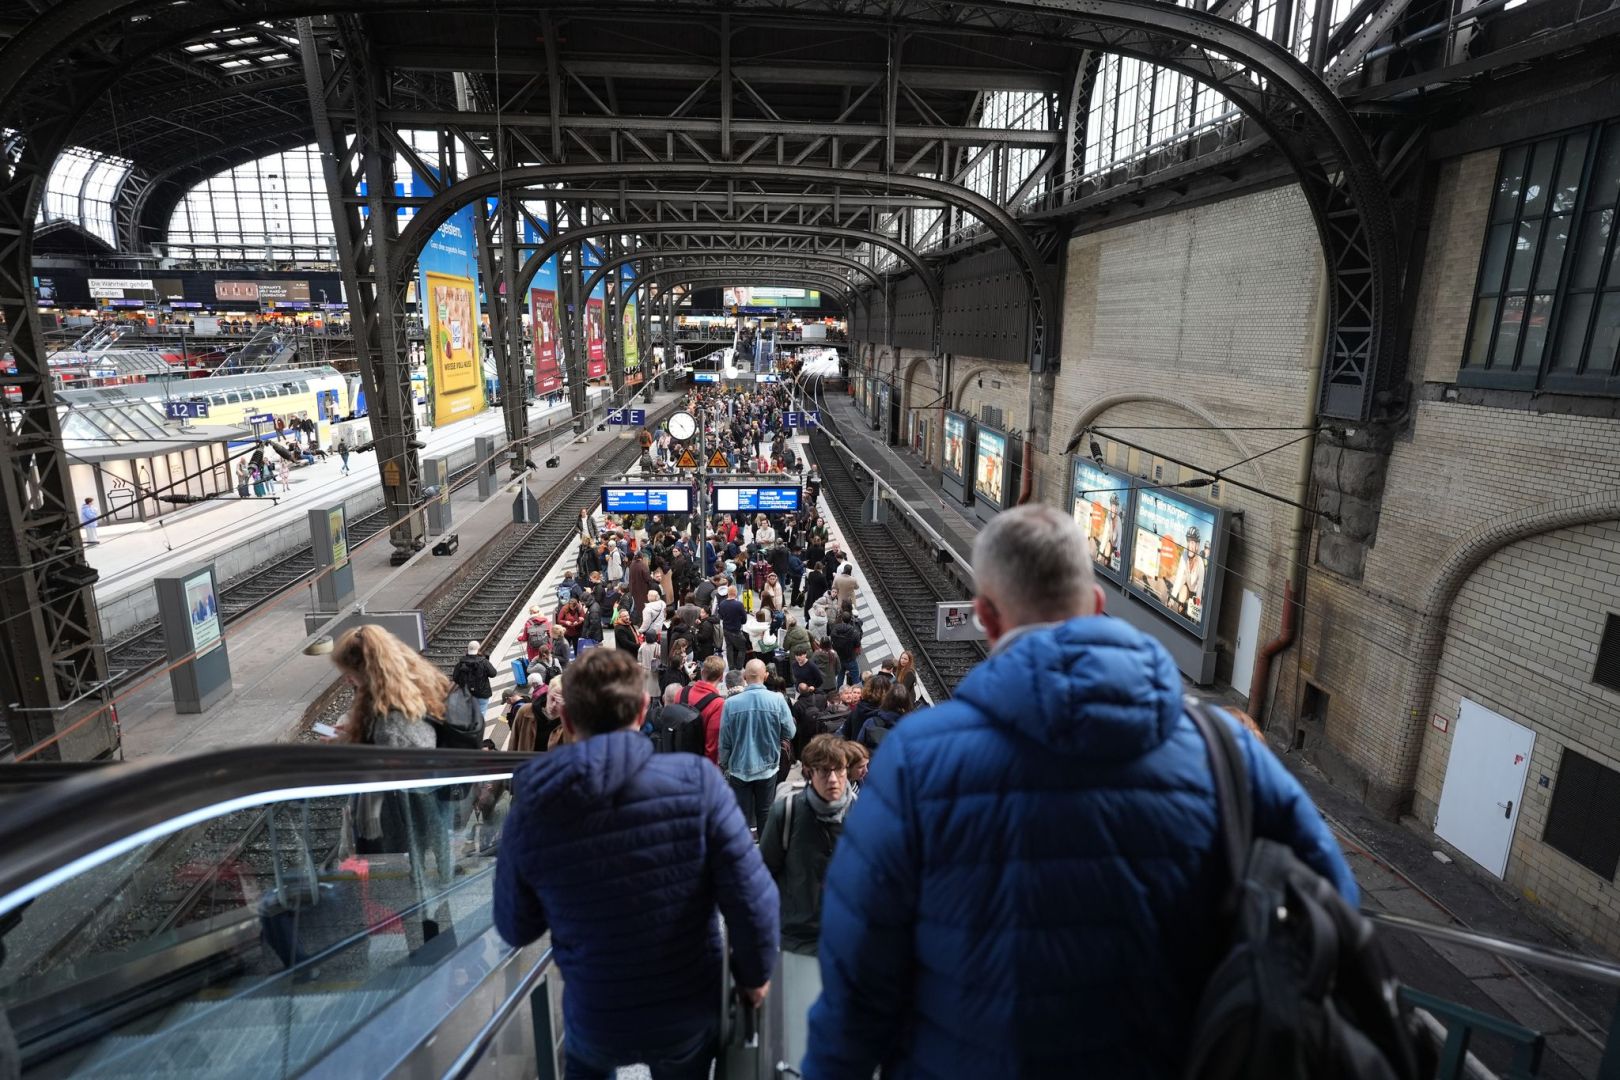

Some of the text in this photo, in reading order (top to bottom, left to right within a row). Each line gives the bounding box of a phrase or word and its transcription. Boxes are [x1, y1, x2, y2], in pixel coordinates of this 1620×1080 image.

[172, 404, 189, 417] 12
[197, 404, 206, 417] E
[610, 410, 622, 422] 13
[630, 410, 639, 423] E
[788, 414, 796, 426] E
